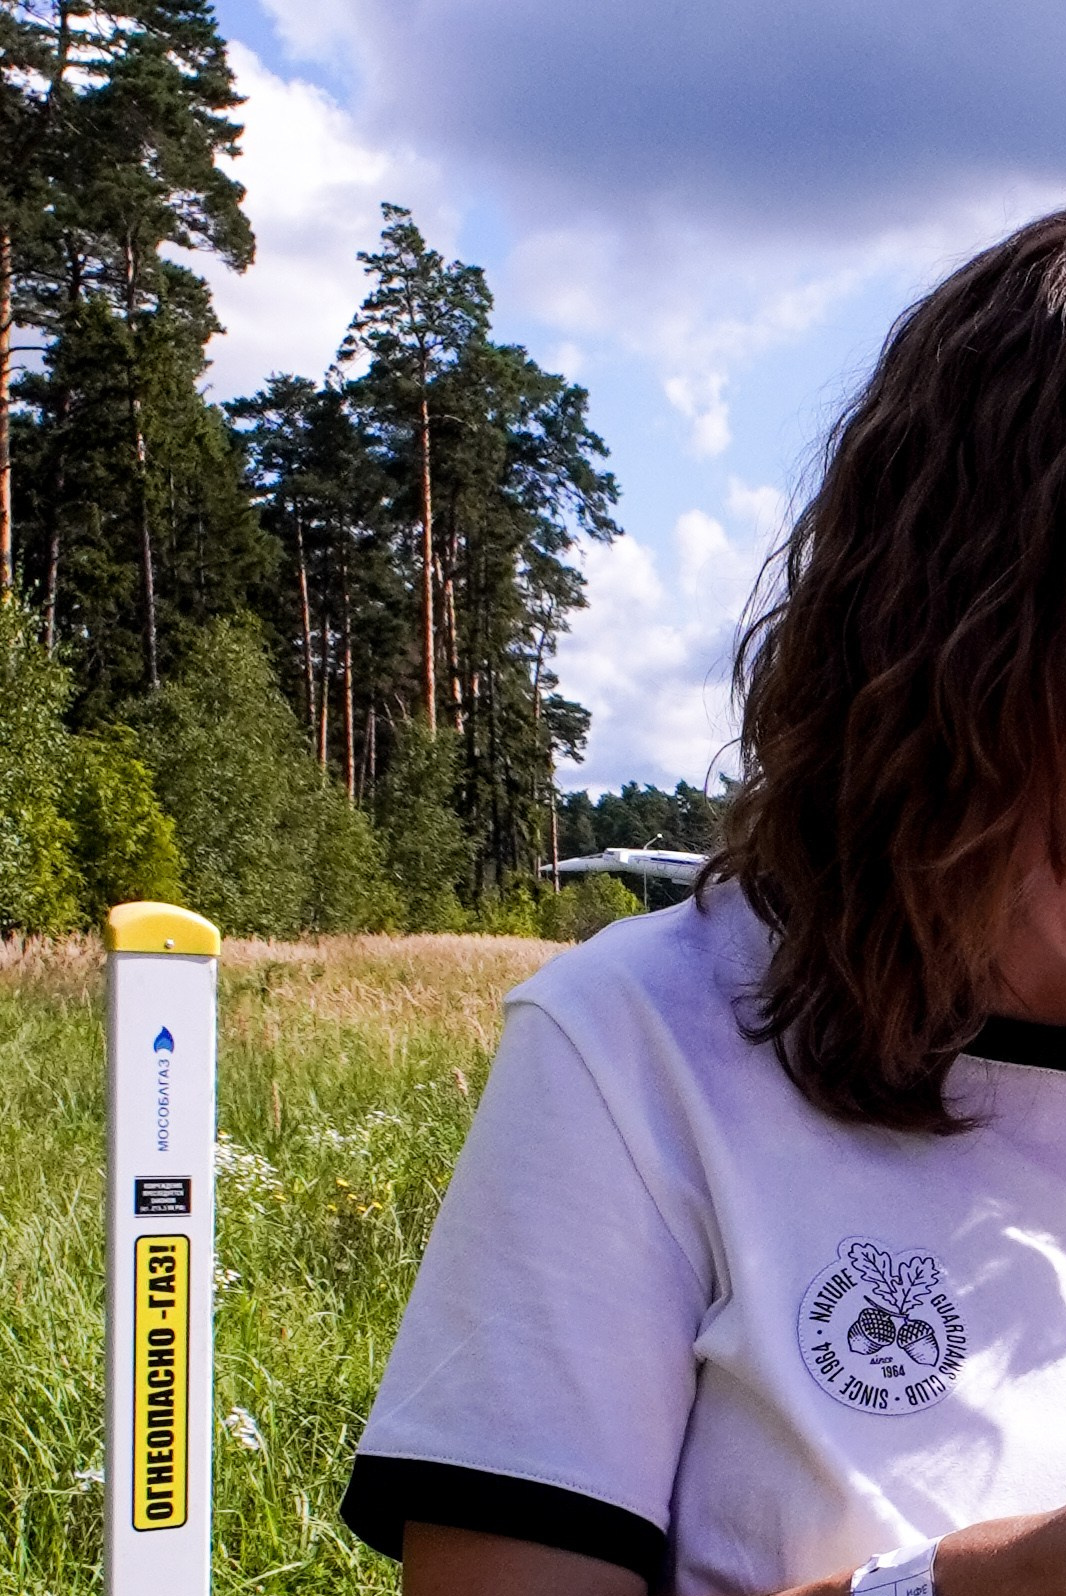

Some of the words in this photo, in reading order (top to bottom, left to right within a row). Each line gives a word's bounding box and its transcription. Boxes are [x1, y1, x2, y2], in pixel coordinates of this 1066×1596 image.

[157, 1058, 171, 1152] МОСОБЛГАЗ
[809, 1268, 858, 1323] NATURE
[930, 1293, 967, 1381] GUARDIANS
[811, 1342, 845, 1382] 1964
[881, 1364, 906, 1379] 1964
[839, 1375, 889, 1409] SINCE
[905, 1374, 946, 1406] CLUB
[146, 1327, 176, 1521] ОГНЕОПАСНО
